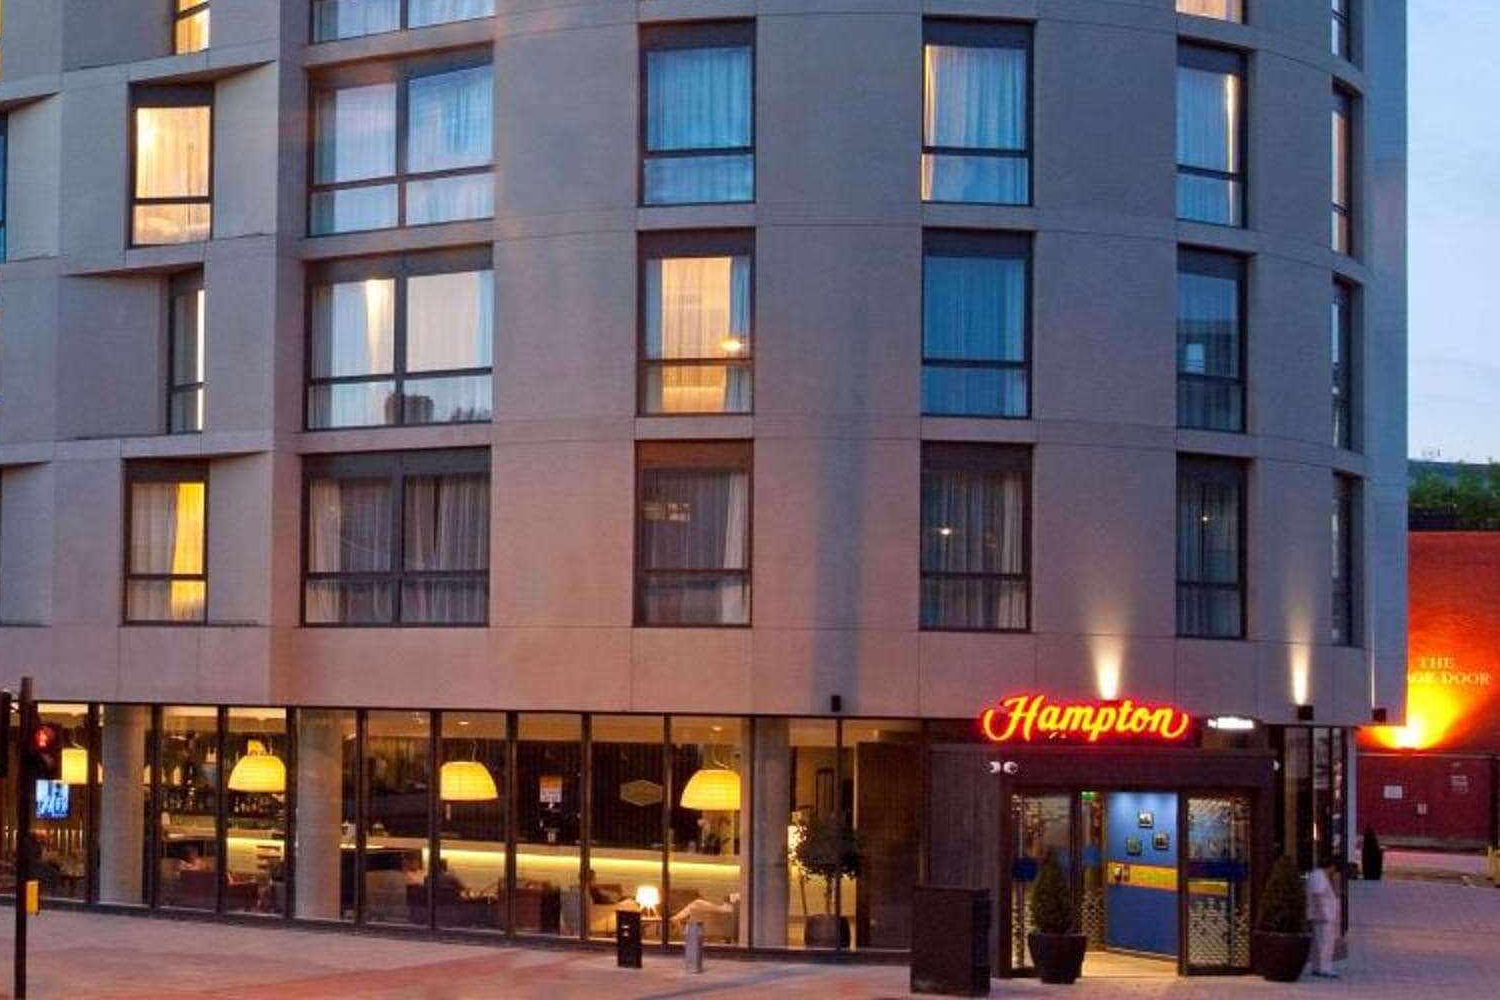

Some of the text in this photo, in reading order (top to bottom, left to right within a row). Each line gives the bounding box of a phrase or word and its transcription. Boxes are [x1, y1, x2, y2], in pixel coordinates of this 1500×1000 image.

[1419, 655, 1454, 669] THE
[1441, 671, 1492, 685] DOOR
[983, 695, 1189, 742] Hampton
